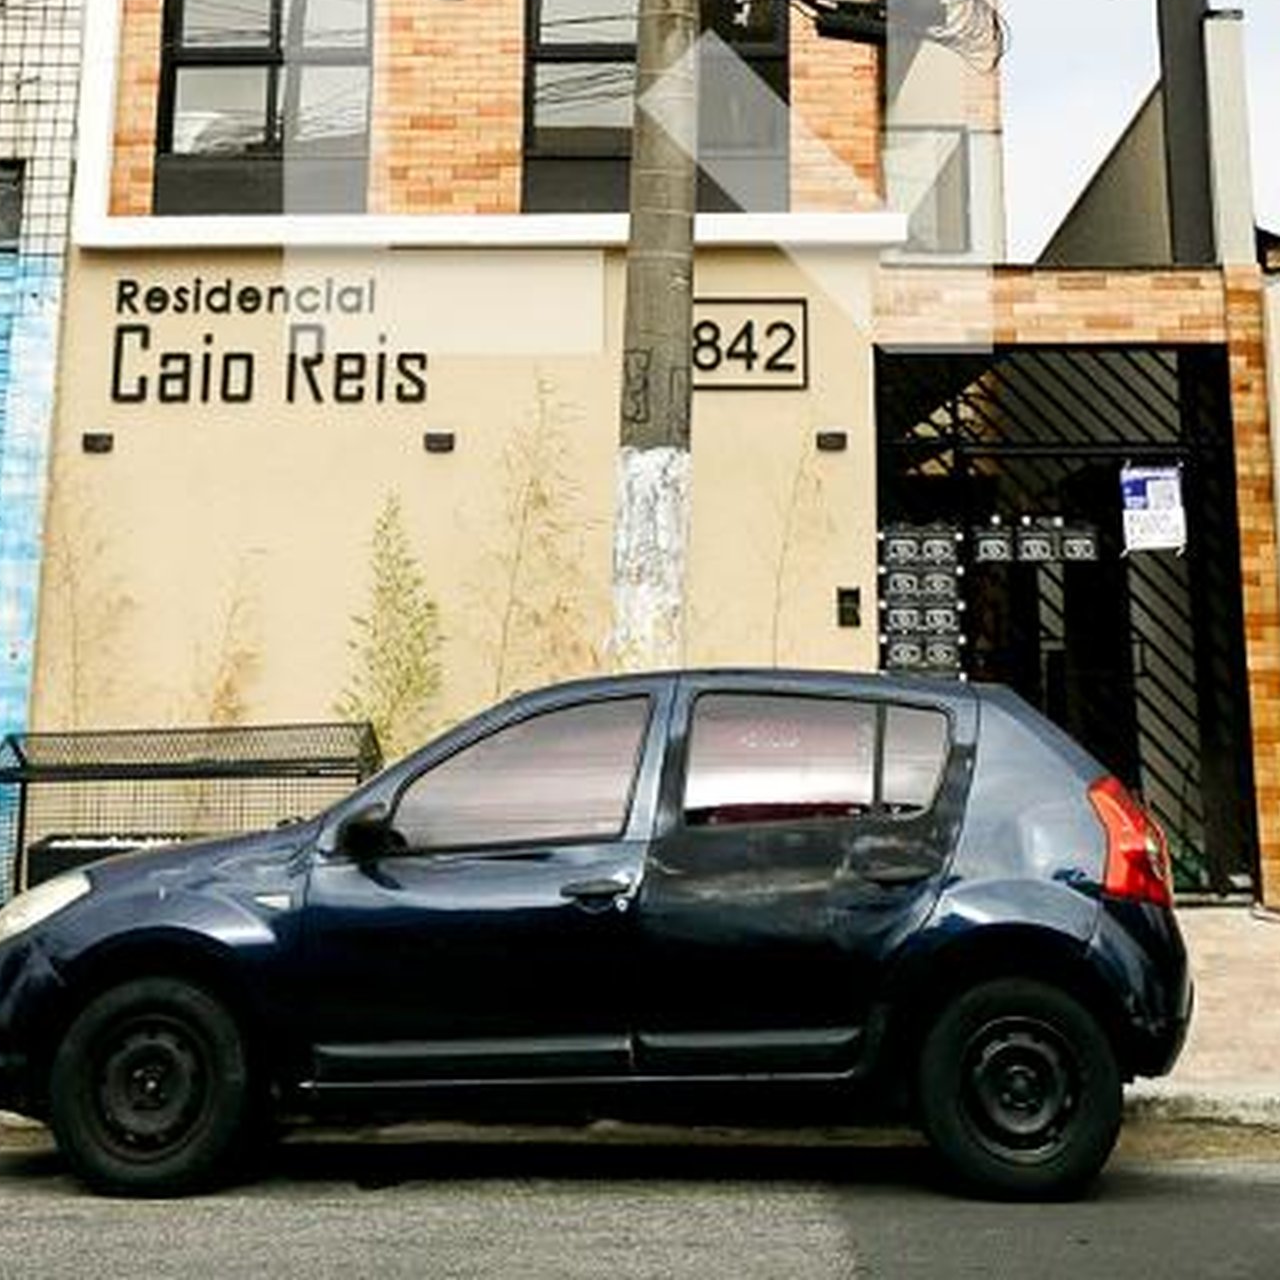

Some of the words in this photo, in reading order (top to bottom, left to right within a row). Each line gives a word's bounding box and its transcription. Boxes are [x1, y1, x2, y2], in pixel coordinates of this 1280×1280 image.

[116, 277, 375, 313] Residencial
[111, 323, 255, 404] Caio
[286, 323, 427, 404] Reis
